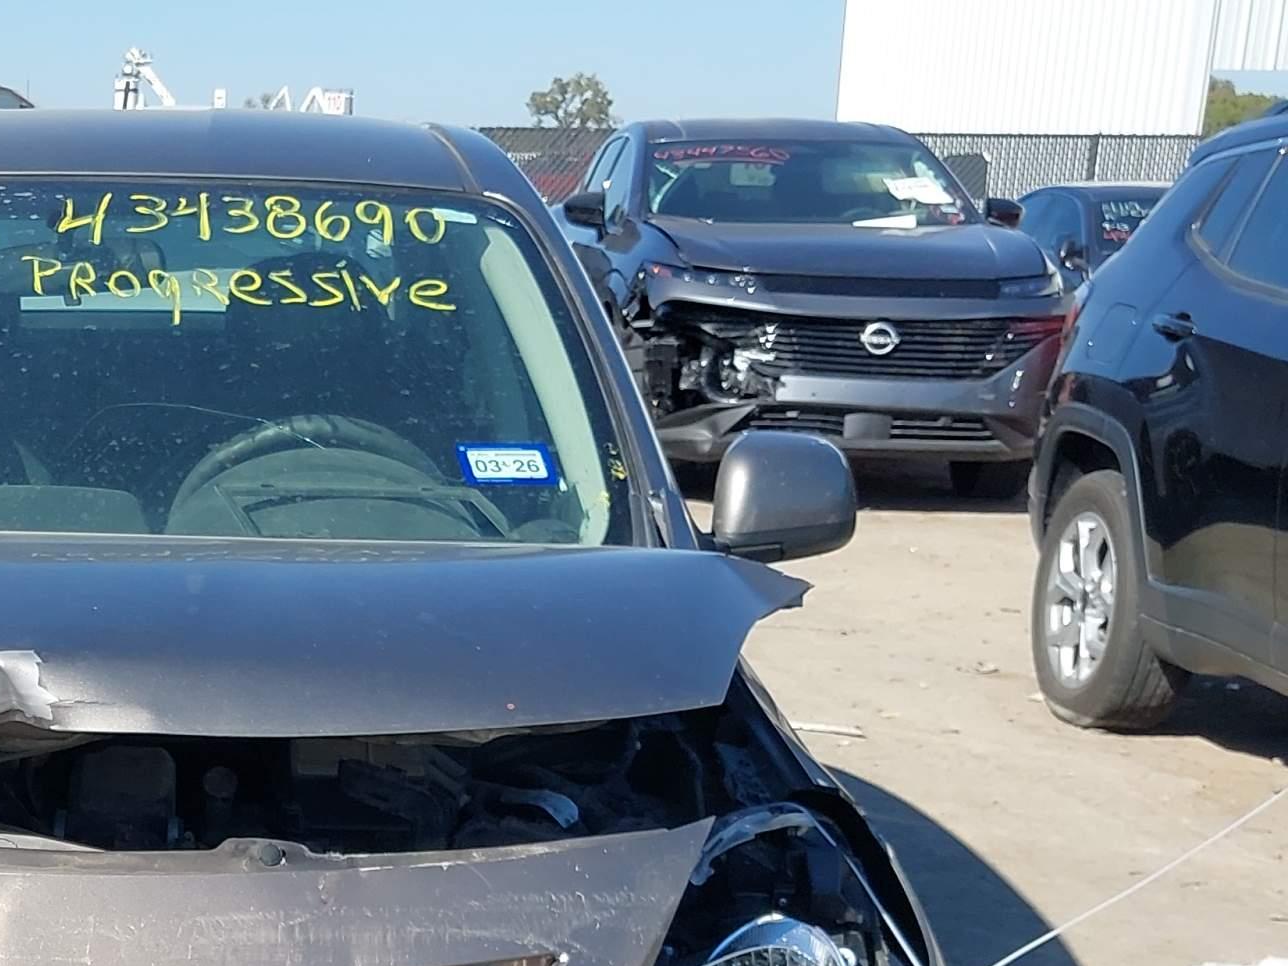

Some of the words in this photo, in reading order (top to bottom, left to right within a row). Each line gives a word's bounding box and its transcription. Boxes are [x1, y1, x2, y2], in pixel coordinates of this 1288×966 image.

[58, 192, 446, 246] 43438690
[474, 459, 502, 473] 03
[512, 459, 541, 473] 26
